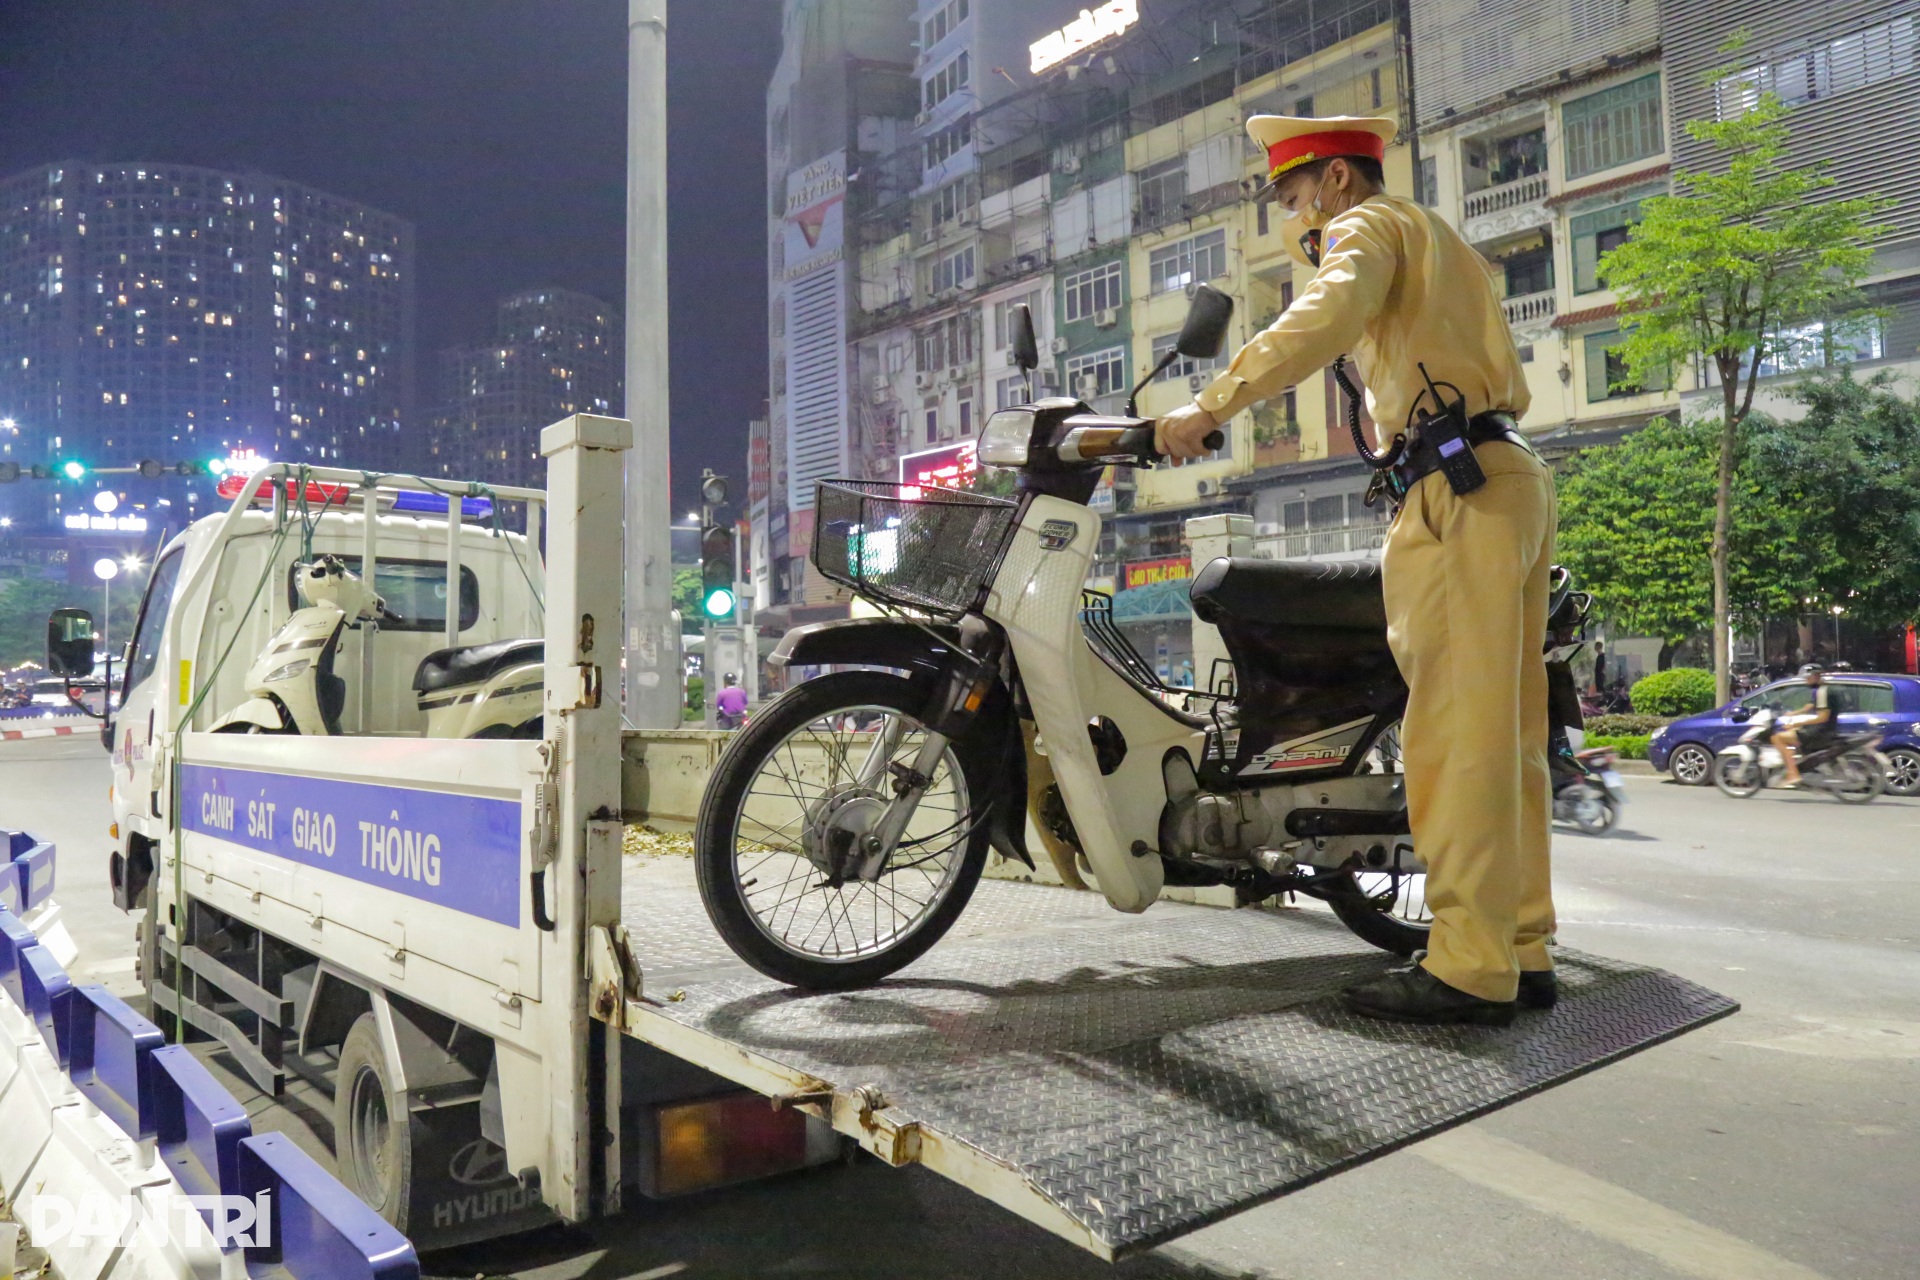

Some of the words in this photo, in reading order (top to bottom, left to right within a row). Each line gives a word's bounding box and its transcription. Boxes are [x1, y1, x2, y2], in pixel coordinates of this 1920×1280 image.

[1251, 749, 1337, 764] DREAM
[202, 777, 235, 832] CẢNH
[247, 788, 276, 841] SÁT
[292, 806, 337, 858] GIAO
[358, 808, 441, 887] THÔNG
